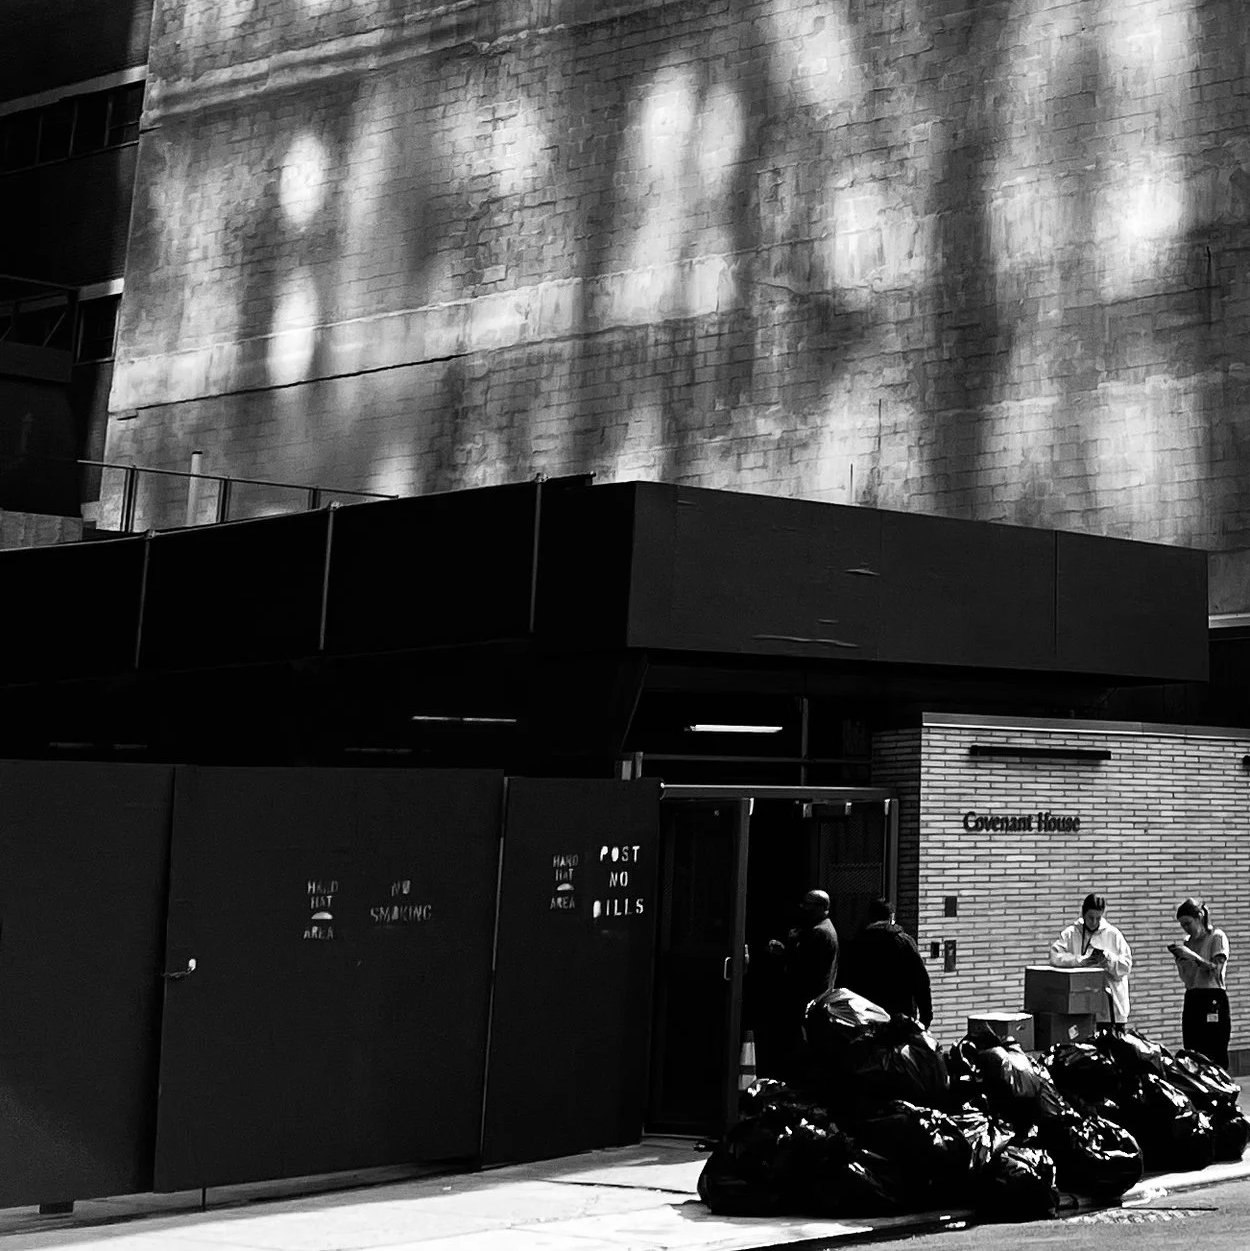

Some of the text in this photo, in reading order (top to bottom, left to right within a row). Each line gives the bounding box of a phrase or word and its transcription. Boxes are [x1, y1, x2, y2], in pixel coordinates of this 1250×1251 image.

[963, 811, 1081, 832] Covenant House
[600, 846, 640, 862] POST
[307, 880, 339, 894] HAD
[609, 871, 628, 888] NO
[550, 896, 575, 910] AREA
